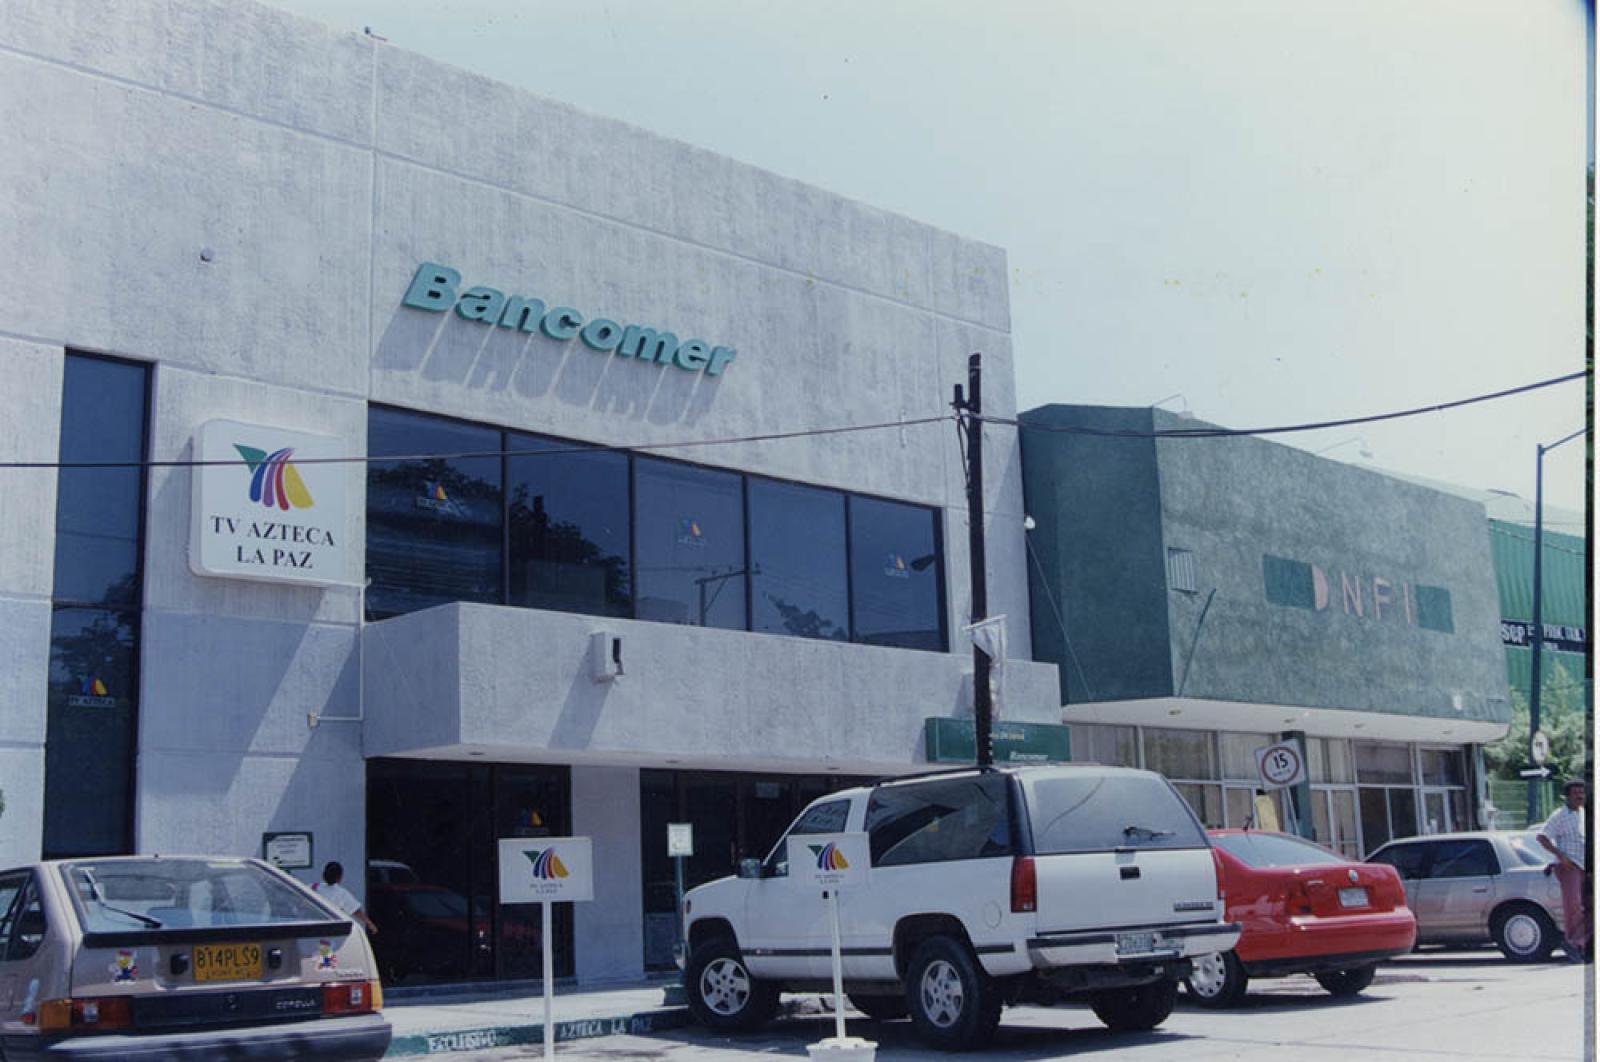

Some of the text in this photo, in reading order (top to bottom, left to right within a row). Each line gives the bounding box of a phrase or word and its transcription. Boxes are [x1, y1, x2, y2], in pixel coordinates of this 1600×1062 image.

[401, 261, 737, 377] Bancomer
[210, 515, 335, 547] TV AZTECA
[237, 545, 313, 569] LA PAZ
[1273, 752, 1289, 770] 15
